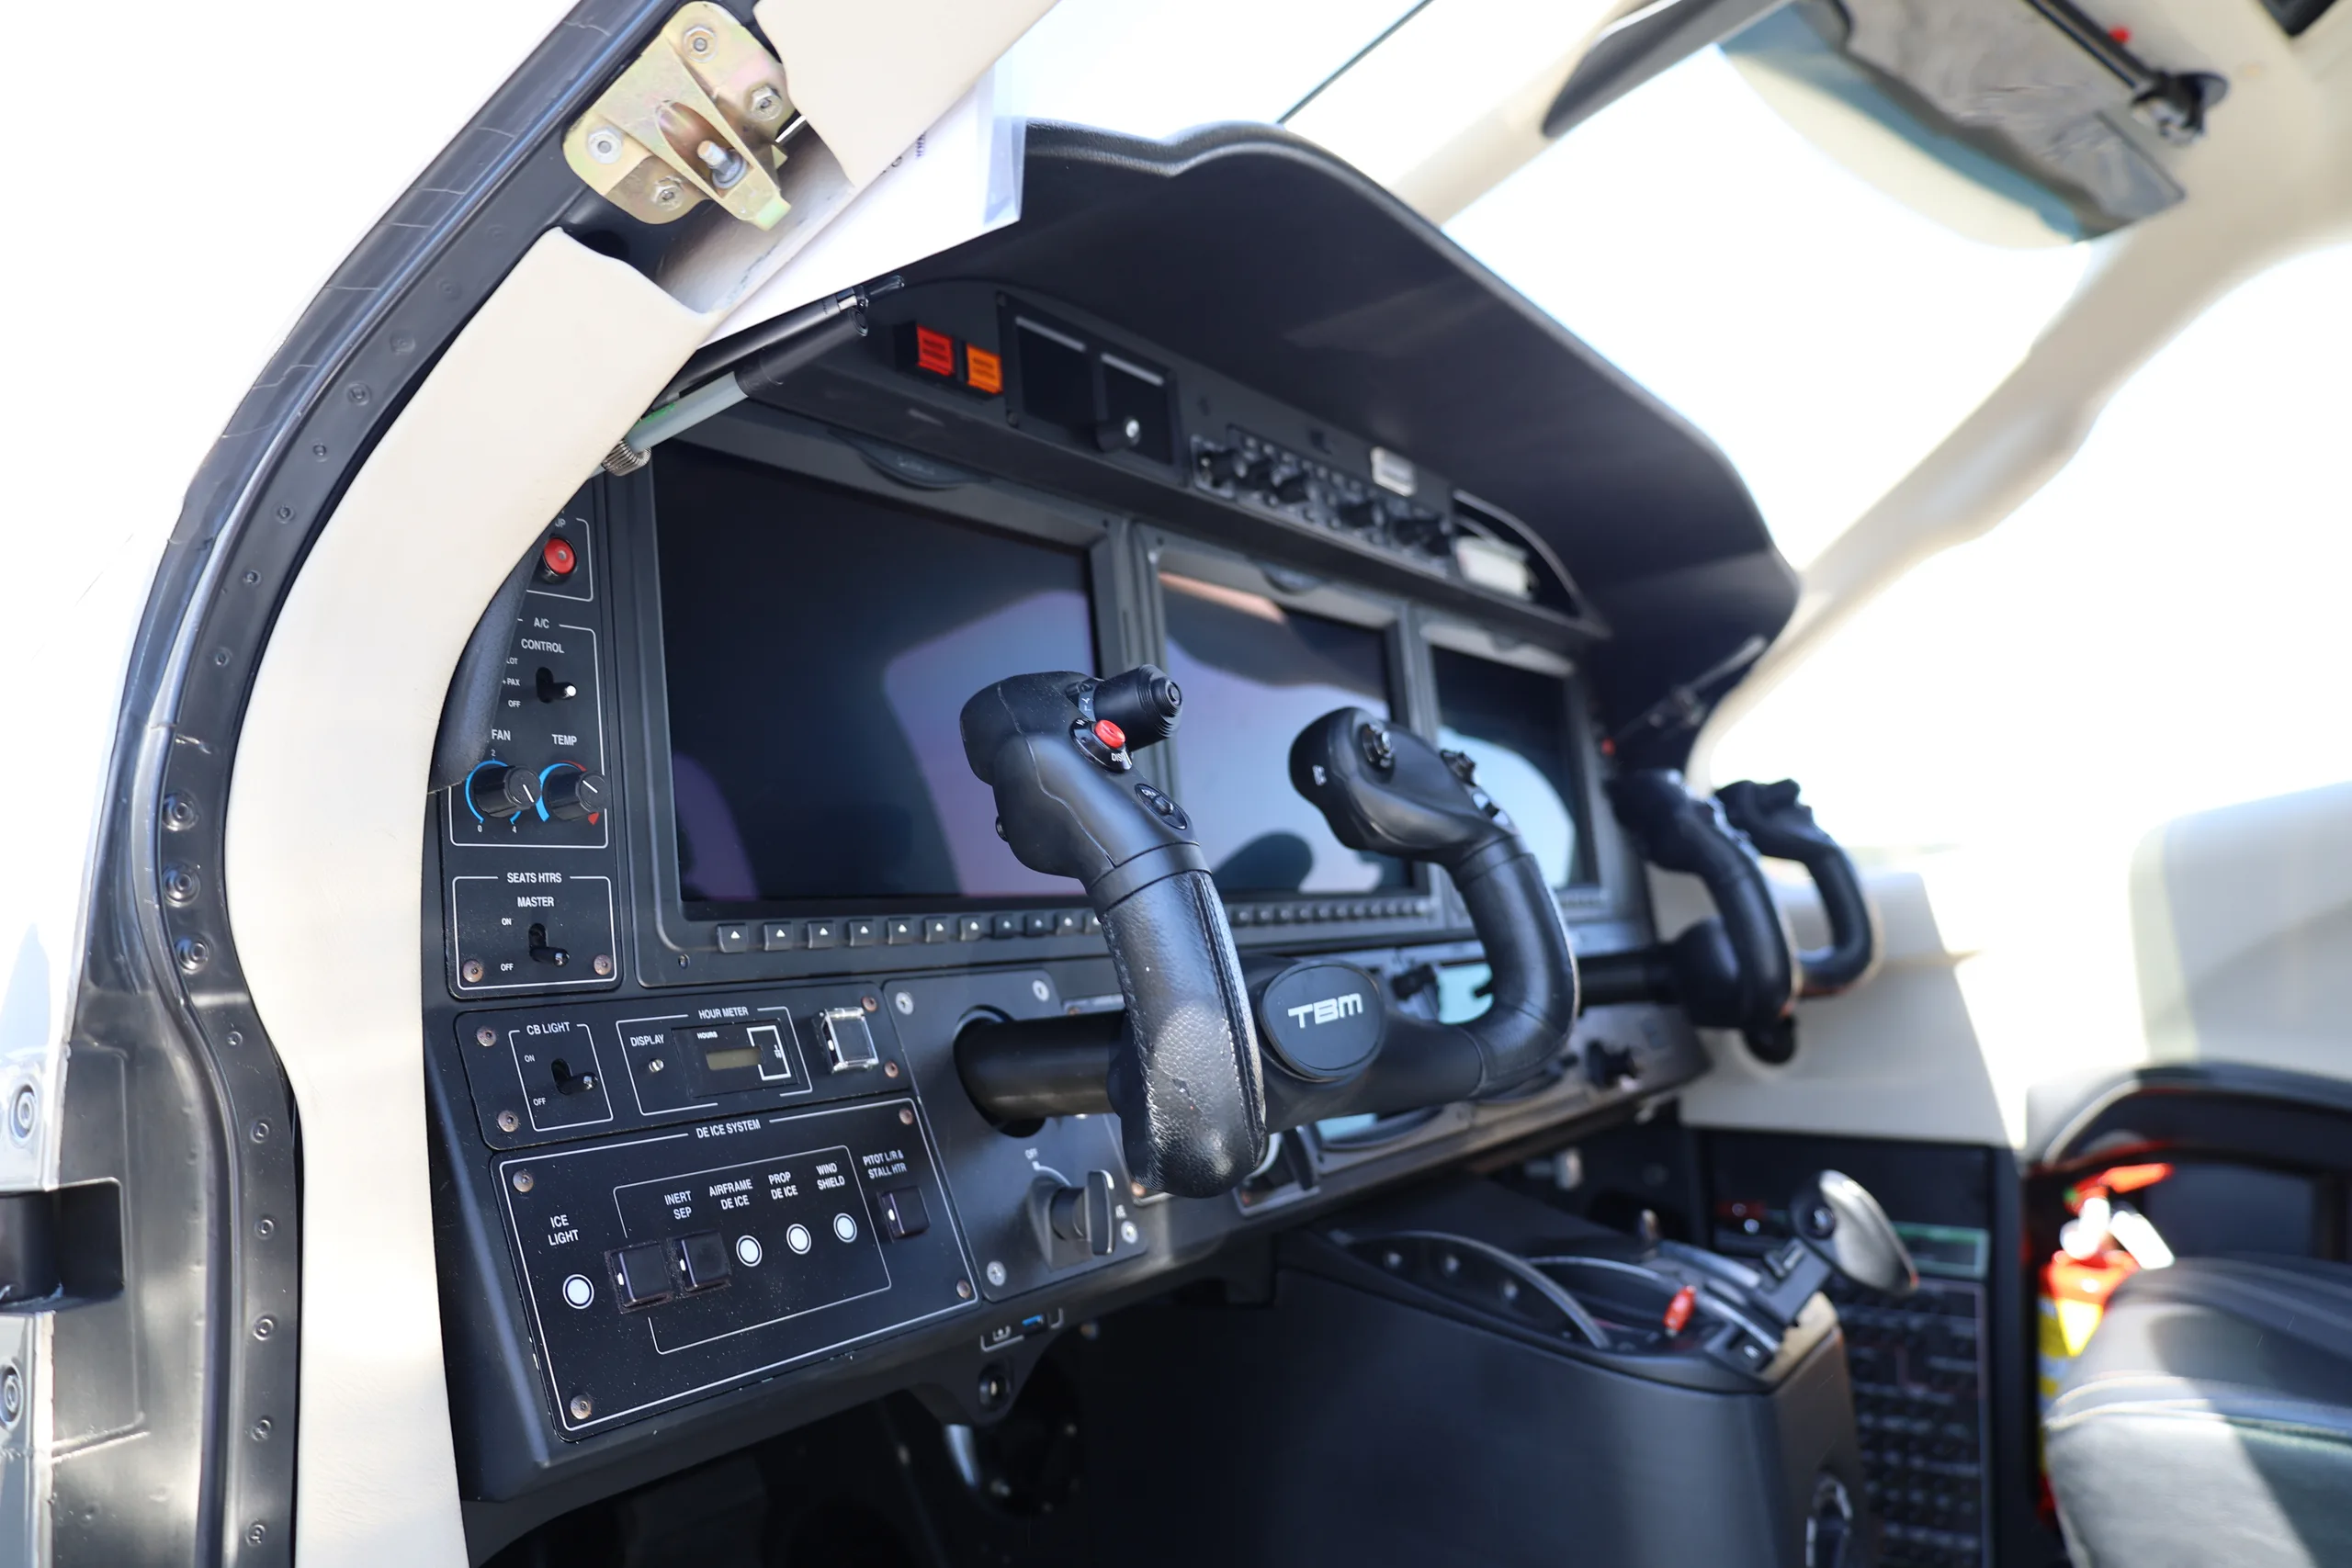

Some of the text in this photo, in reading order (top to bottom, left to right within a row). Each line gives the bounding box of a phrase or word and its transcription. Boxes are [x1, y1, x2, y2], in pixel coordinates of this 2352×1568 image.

[534, 618, 549, 629] A/C
[521, 639, 565, 653] CONTROL
[492, 729, 511, 740] FAN
[552, 734, 577, 746] TEMP
[507, 873, 562, 883] SEATS HTRS
[517, 897, 554, 907] MASTER
[698, 1007, 749, 1020] HOUR METER
[1288, 993, 1363, 1029] TBM
[526, 1022, 570, 1035] CB LIGHT
[630, 1034, 664, 1047] DISPLAY
[525, 1055, 535, 1063] ON
[533, 1098, 546, 1106] OFF
[696, 1120, 761, 1138] DE ICE SYSTEM
[863, 1154, 884, 1166] PITOT
[816, 1162, 838, 1176] WIND
[869, 1163, 907, 1179] STALL HTR
[768, 1172, 791, 1185] PROP
[817, 1175, 845, 1190] SHIELD
[709, 1179, 753, 1198] AIRFRAME
[771, 1186, 798, 1200] DE ICE
[664, 1190, 692, 1205] INERT
[720, 1195, 750, 1210] DE ICE
[673, 1207, 692, 1220] SEP
[550, 1213, 570, 1228] ICE
[548, 1229, 579, 1247] LIGHT
